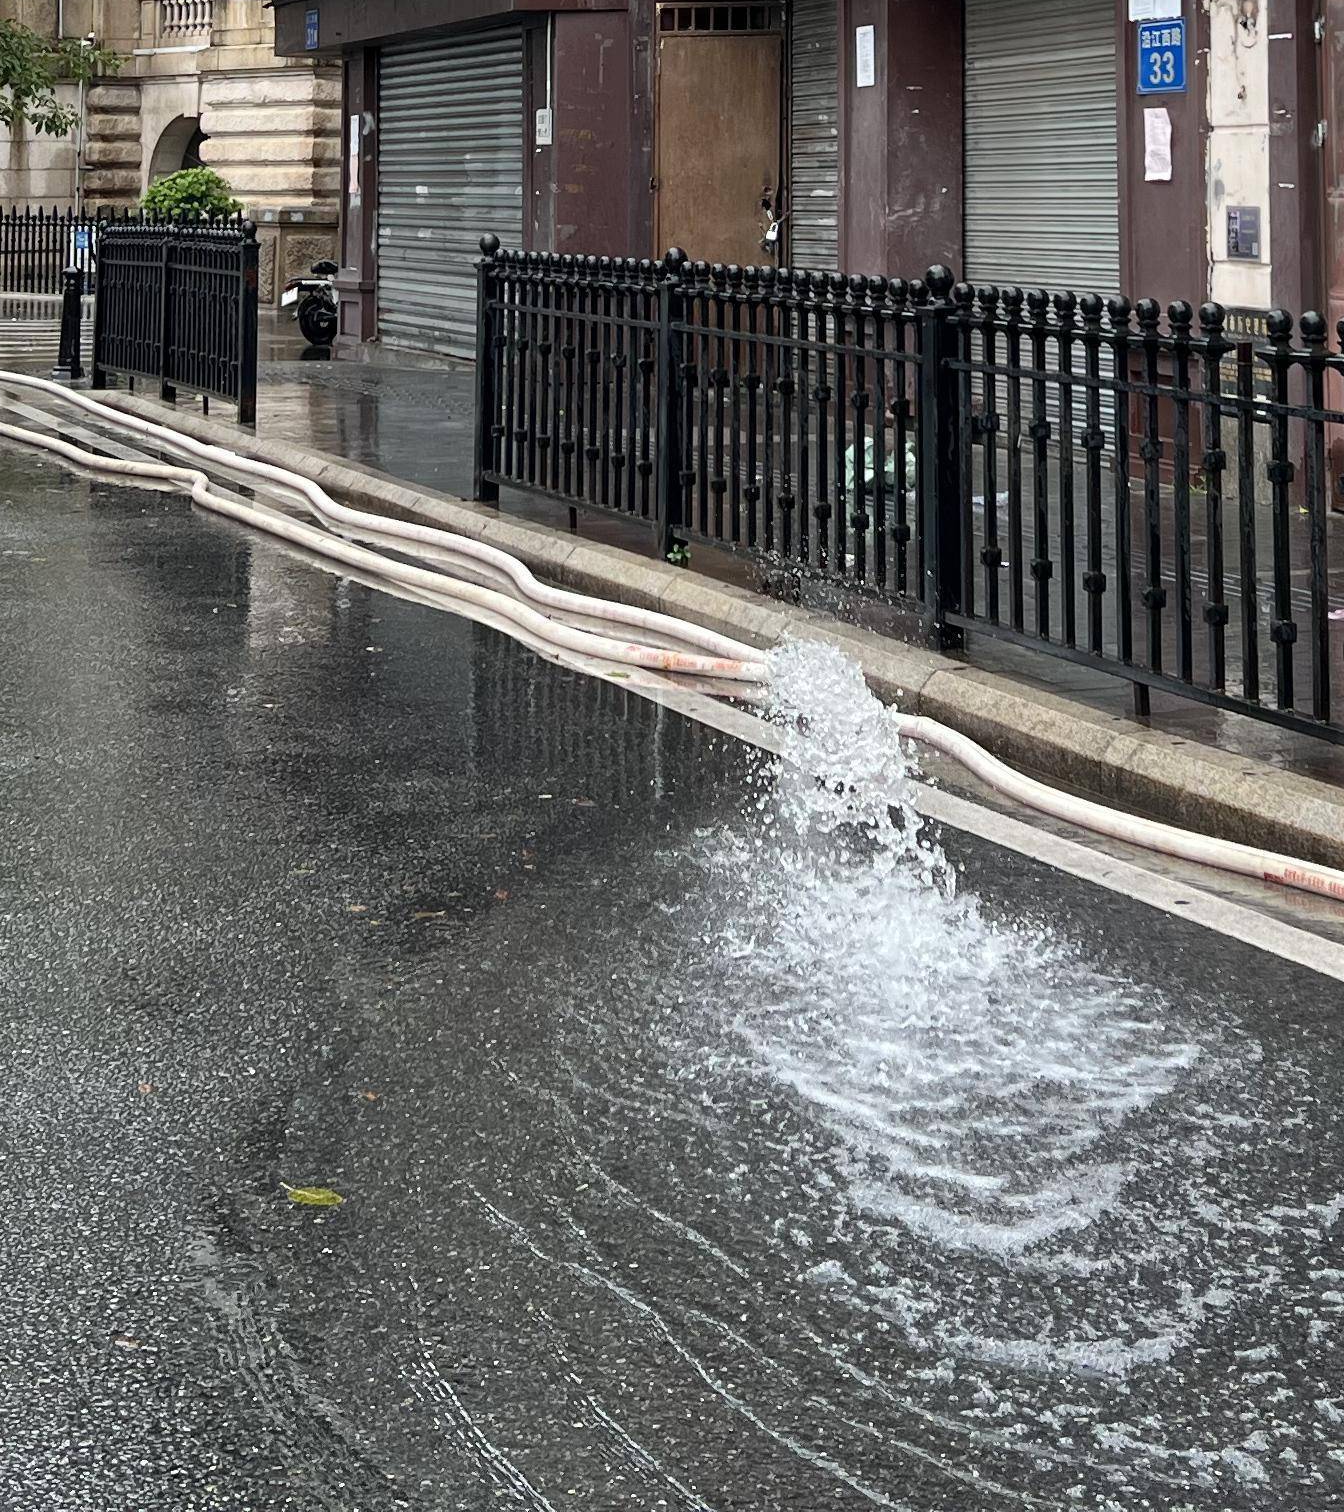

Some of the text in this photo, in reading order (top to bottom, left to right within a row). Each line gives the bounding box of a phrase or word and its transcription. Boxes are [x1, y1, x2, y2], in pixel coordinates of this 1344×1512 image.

[1141, 27, 1182, 49] 沿江西路
[1149, 51, 1176, 85] 33
